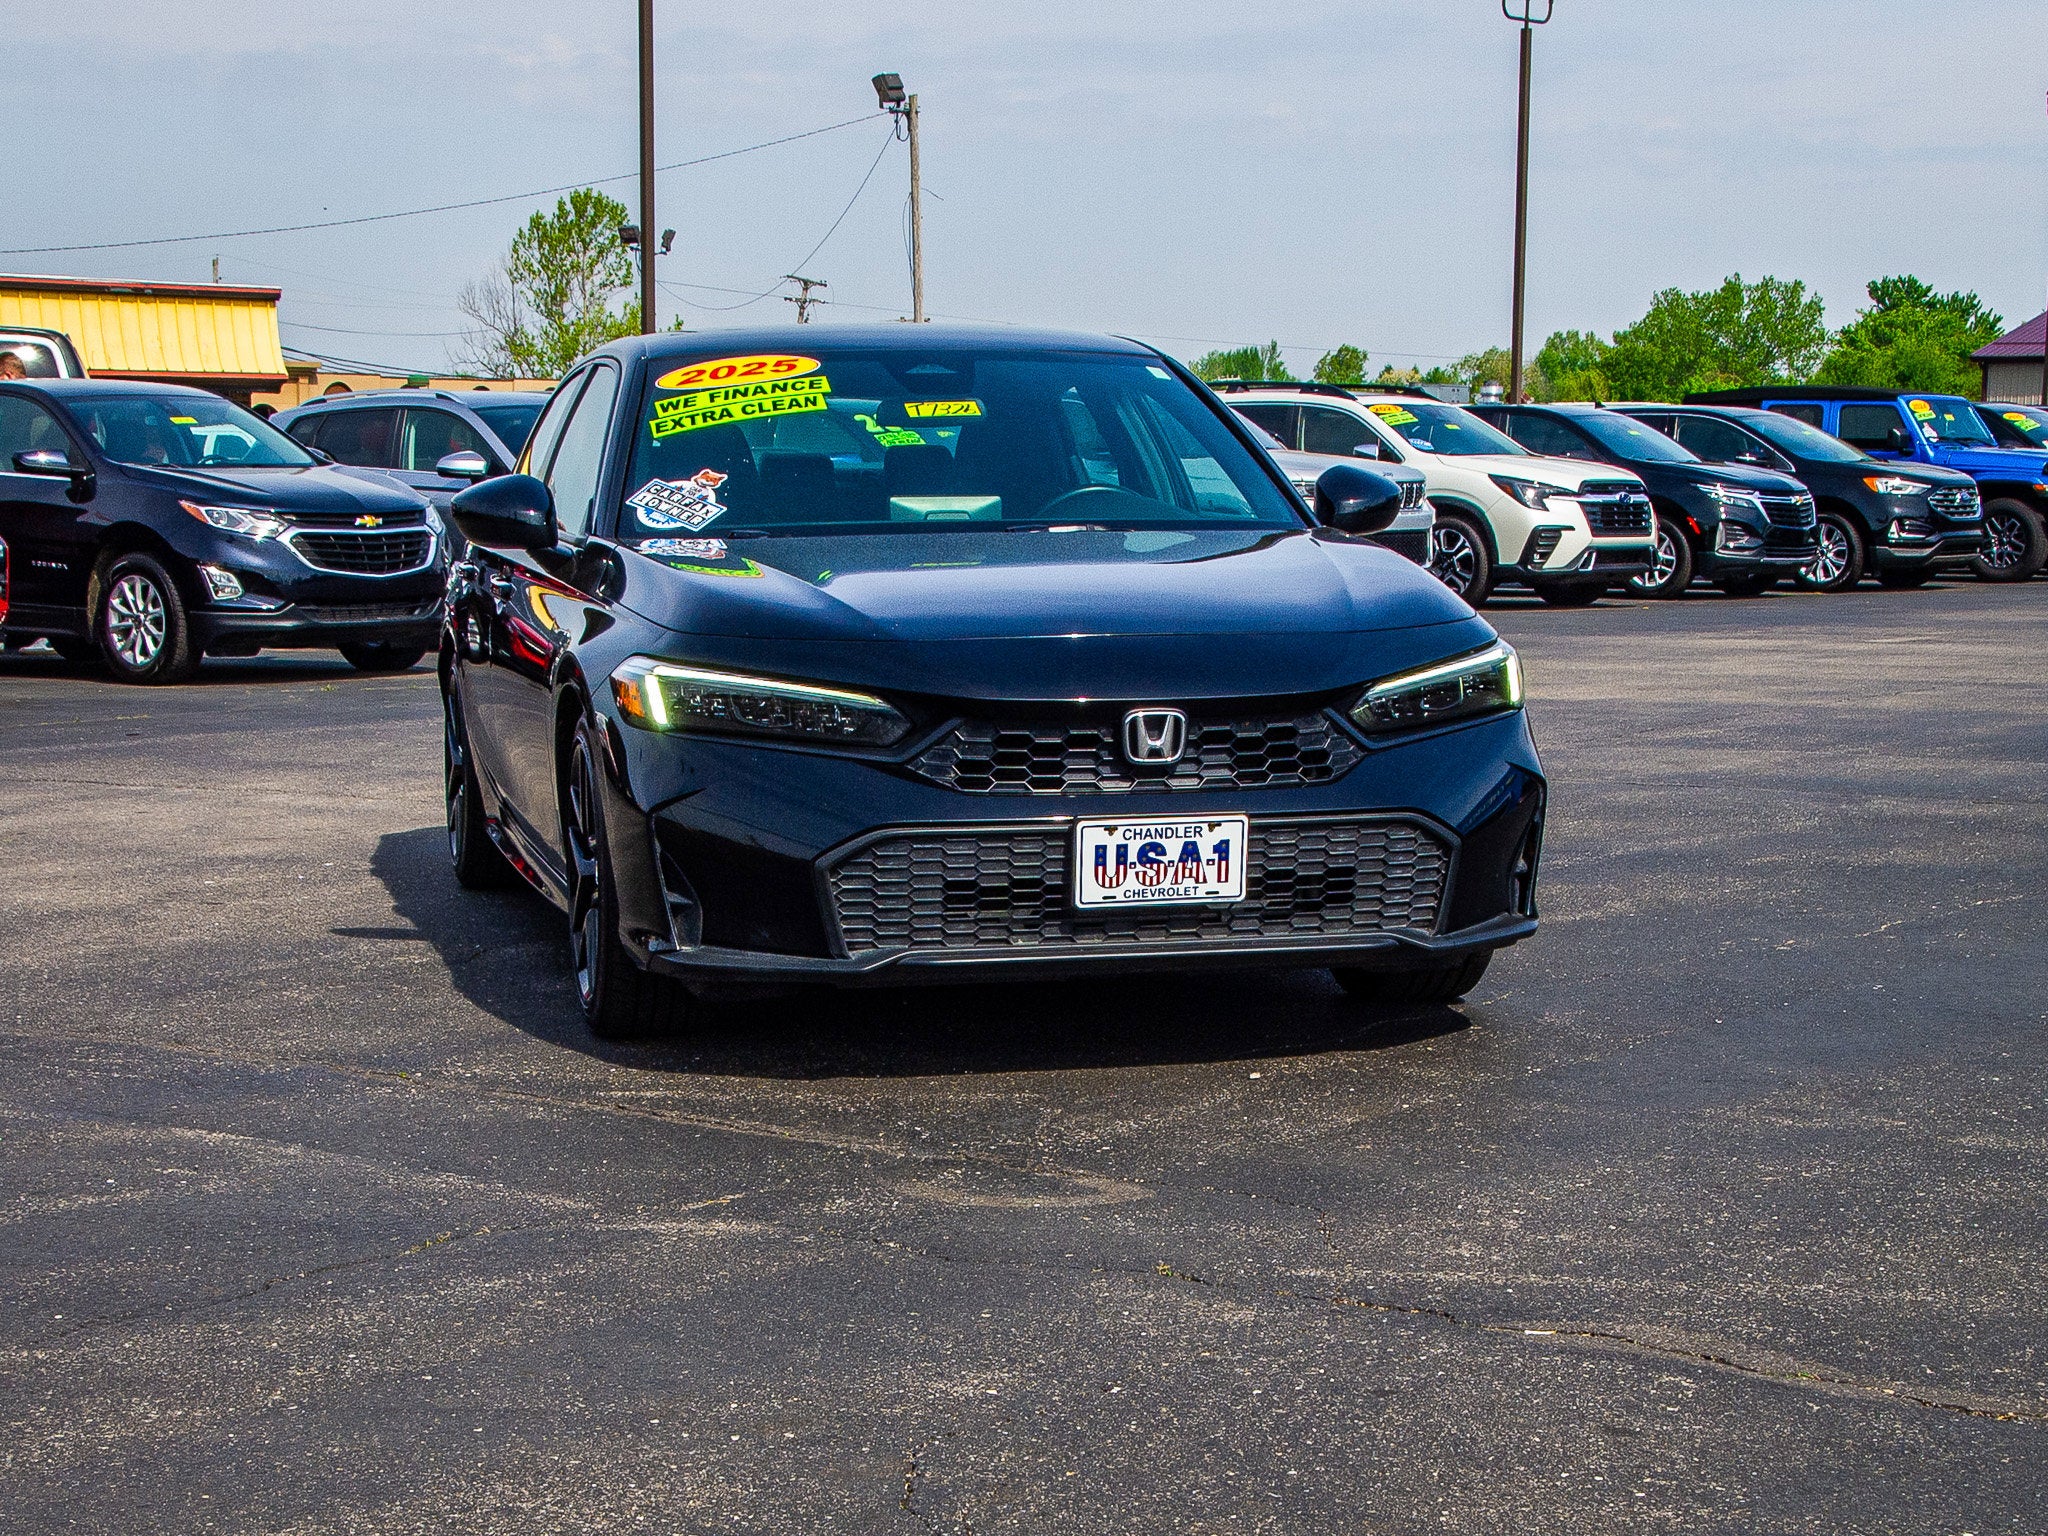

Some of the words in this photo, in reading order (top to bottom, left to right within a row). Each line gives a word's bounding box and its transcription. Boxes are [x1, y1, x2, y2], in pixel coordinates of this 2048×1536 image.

[676, 359, 799, 386] 2025
[659, 396, 697, 414] WE
[709, 378, 823, 403] FINANCE
[655, 407, 734, 434] EXTRA
[741, 395, 818, 416] CLEAN
[647, 483, 713, 517] CARFAX
[1122, 826, 1203, 841] CHANDLER
[1123, 886, 1200, 899] CHEVROLET
